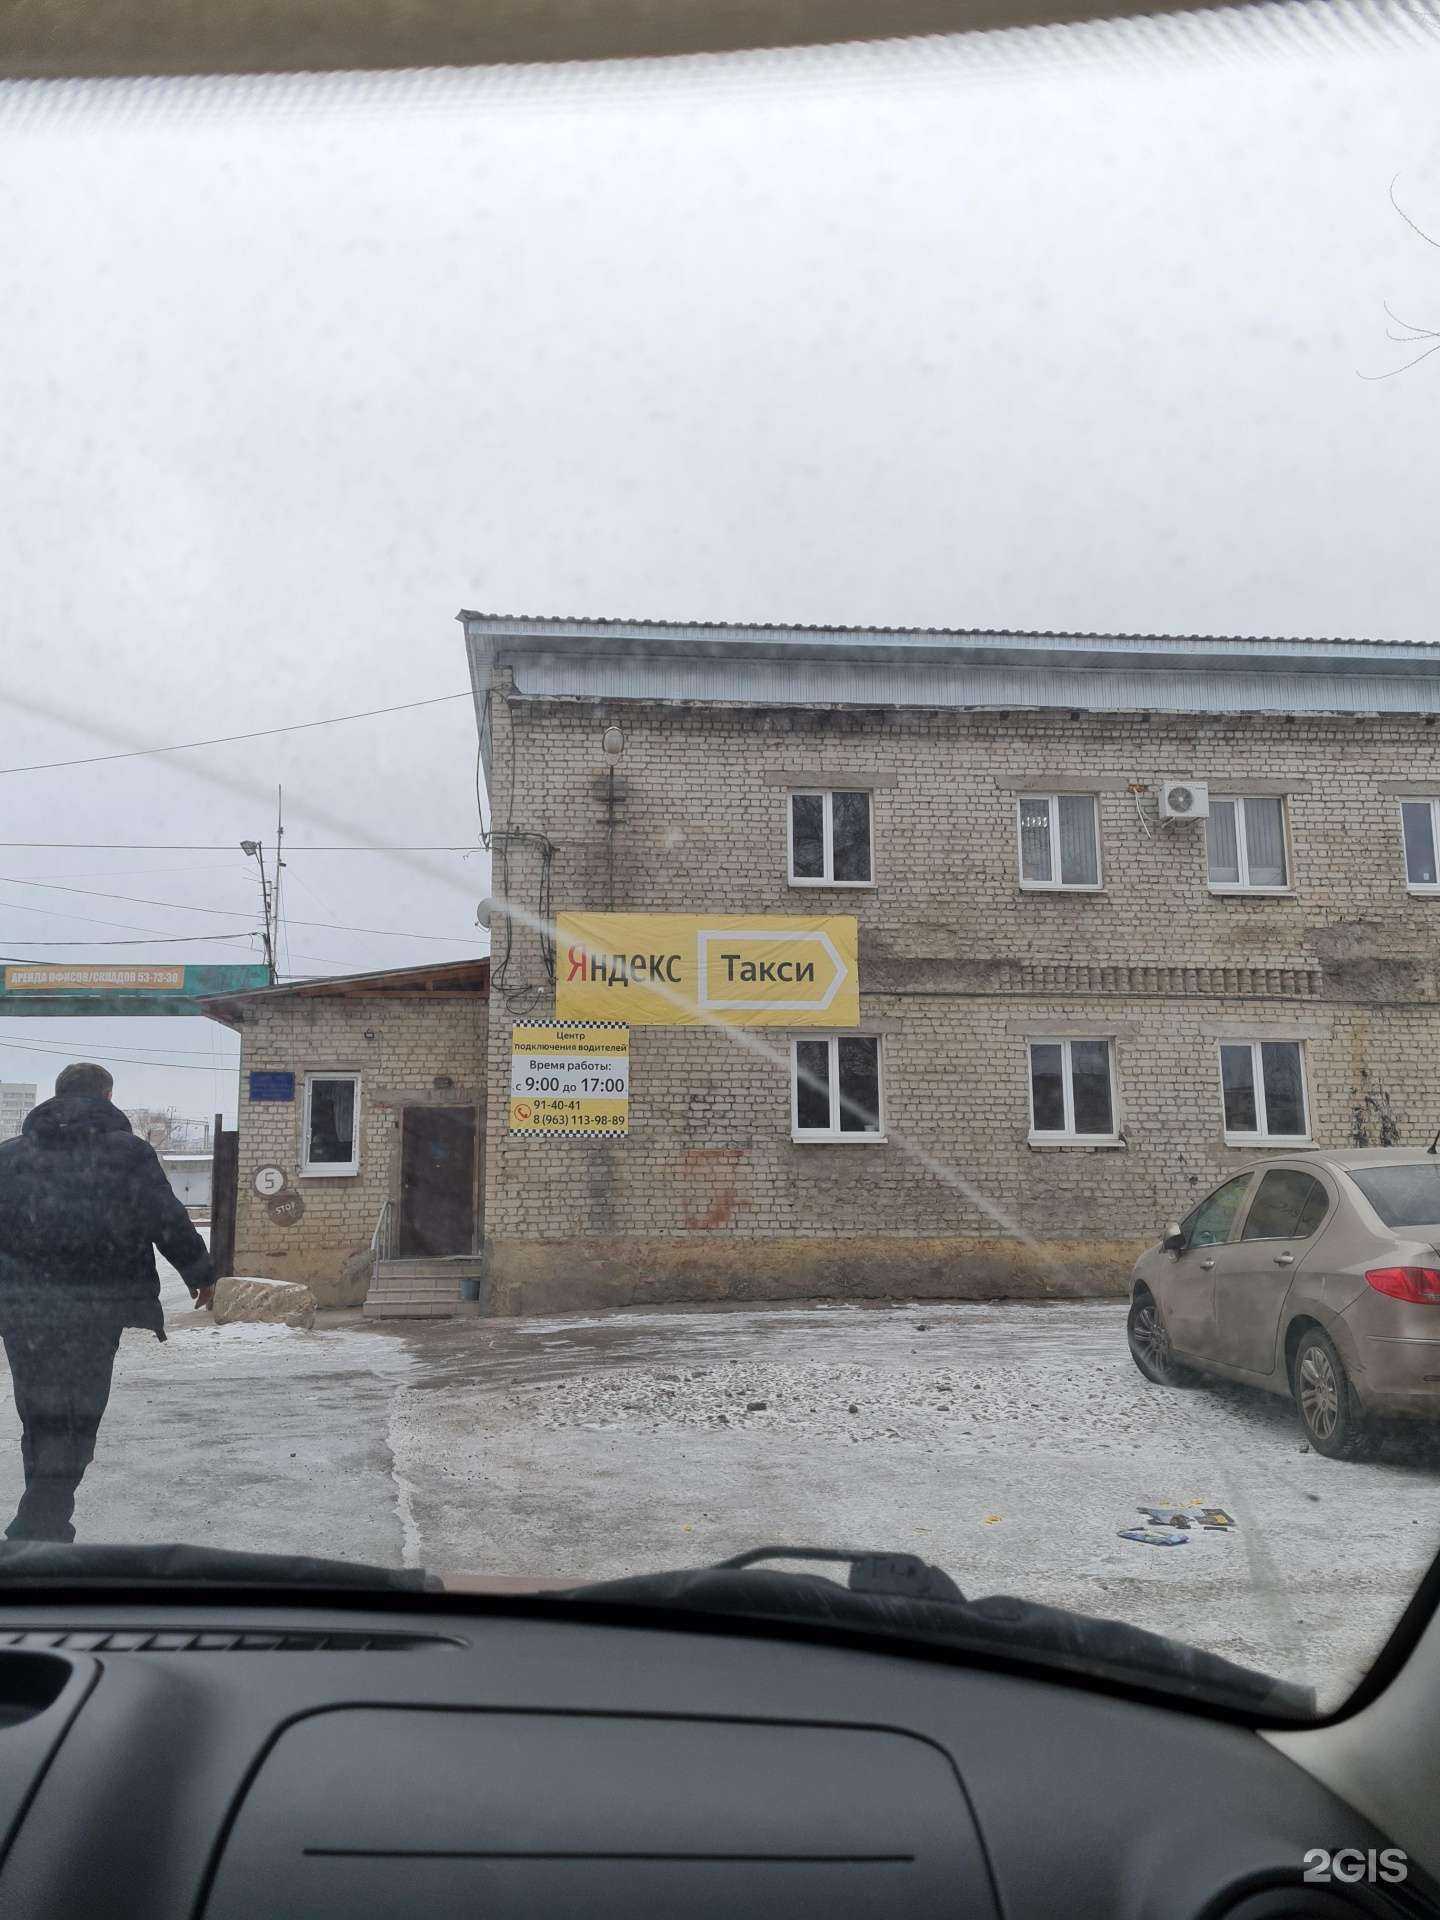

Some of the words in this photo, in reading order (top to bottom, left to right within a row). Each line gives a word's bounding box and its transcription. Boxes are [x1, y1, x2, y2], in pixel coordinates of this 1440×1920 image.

[567, 944, 682, 987] Яндекс
[721, 954, 814, 982] Такси
[11, 972, 48, 984] АРЕНДА
[556, 1032, 586, 1041] Центр
[514, 1043, 576, 1052] подключения
[578, 1043, 627, 1052] водителей
[529, 1060, 565, 1071] Время
[567, 1061, 612, 1072] работы:
[515, 1083, 521, 1091] с
[525, 1077, 560, 1092] 9:00
[562, 1083, 577, 1093] до
[581, 1078, 625, 1092] 17:00
[533, 1100, 581, 1110] 91-40-41
[533, 1115, 540, 1124] 8
[542, 1115, 569, 1126] (963)
[572, 1115, 625, 1125] 113-98-89
[264, 1172, 274, 1189] 5
